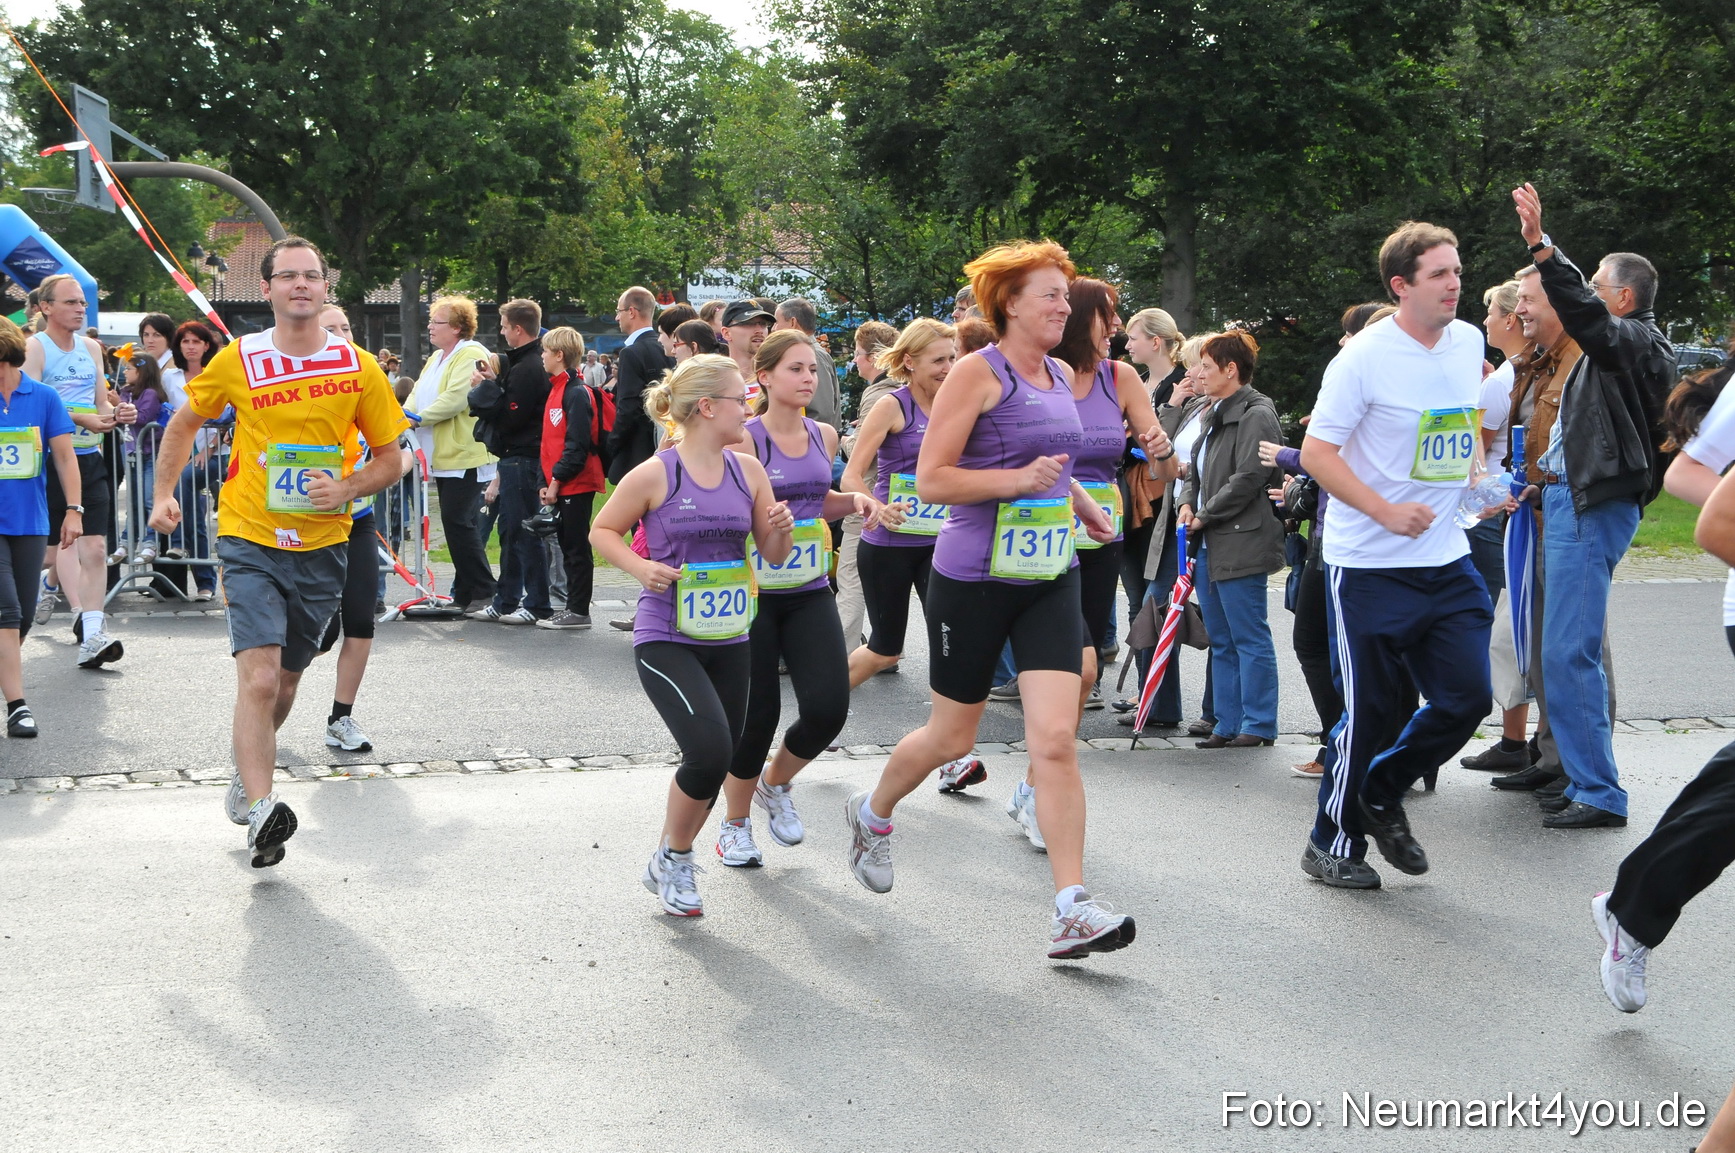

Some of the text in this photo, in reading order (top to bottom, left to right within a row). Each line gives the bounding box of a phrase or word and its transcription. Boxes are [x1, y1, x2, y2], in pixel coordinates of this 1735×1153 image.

[251, 379, 364, 411] MAX BÖGL
[0, 444, 20, 466] 3
[1421, 432, 1473, 461] 1019
[670, 516, 697, 525] Manfred
[751, 543, 816, 571] 121
[1001, 528, 1069, 558] 1317
[1017, 560, 1039, 568] Luise
[684, 588, 747, 619] 1320
[696, 621, 723, 629] Cristina
